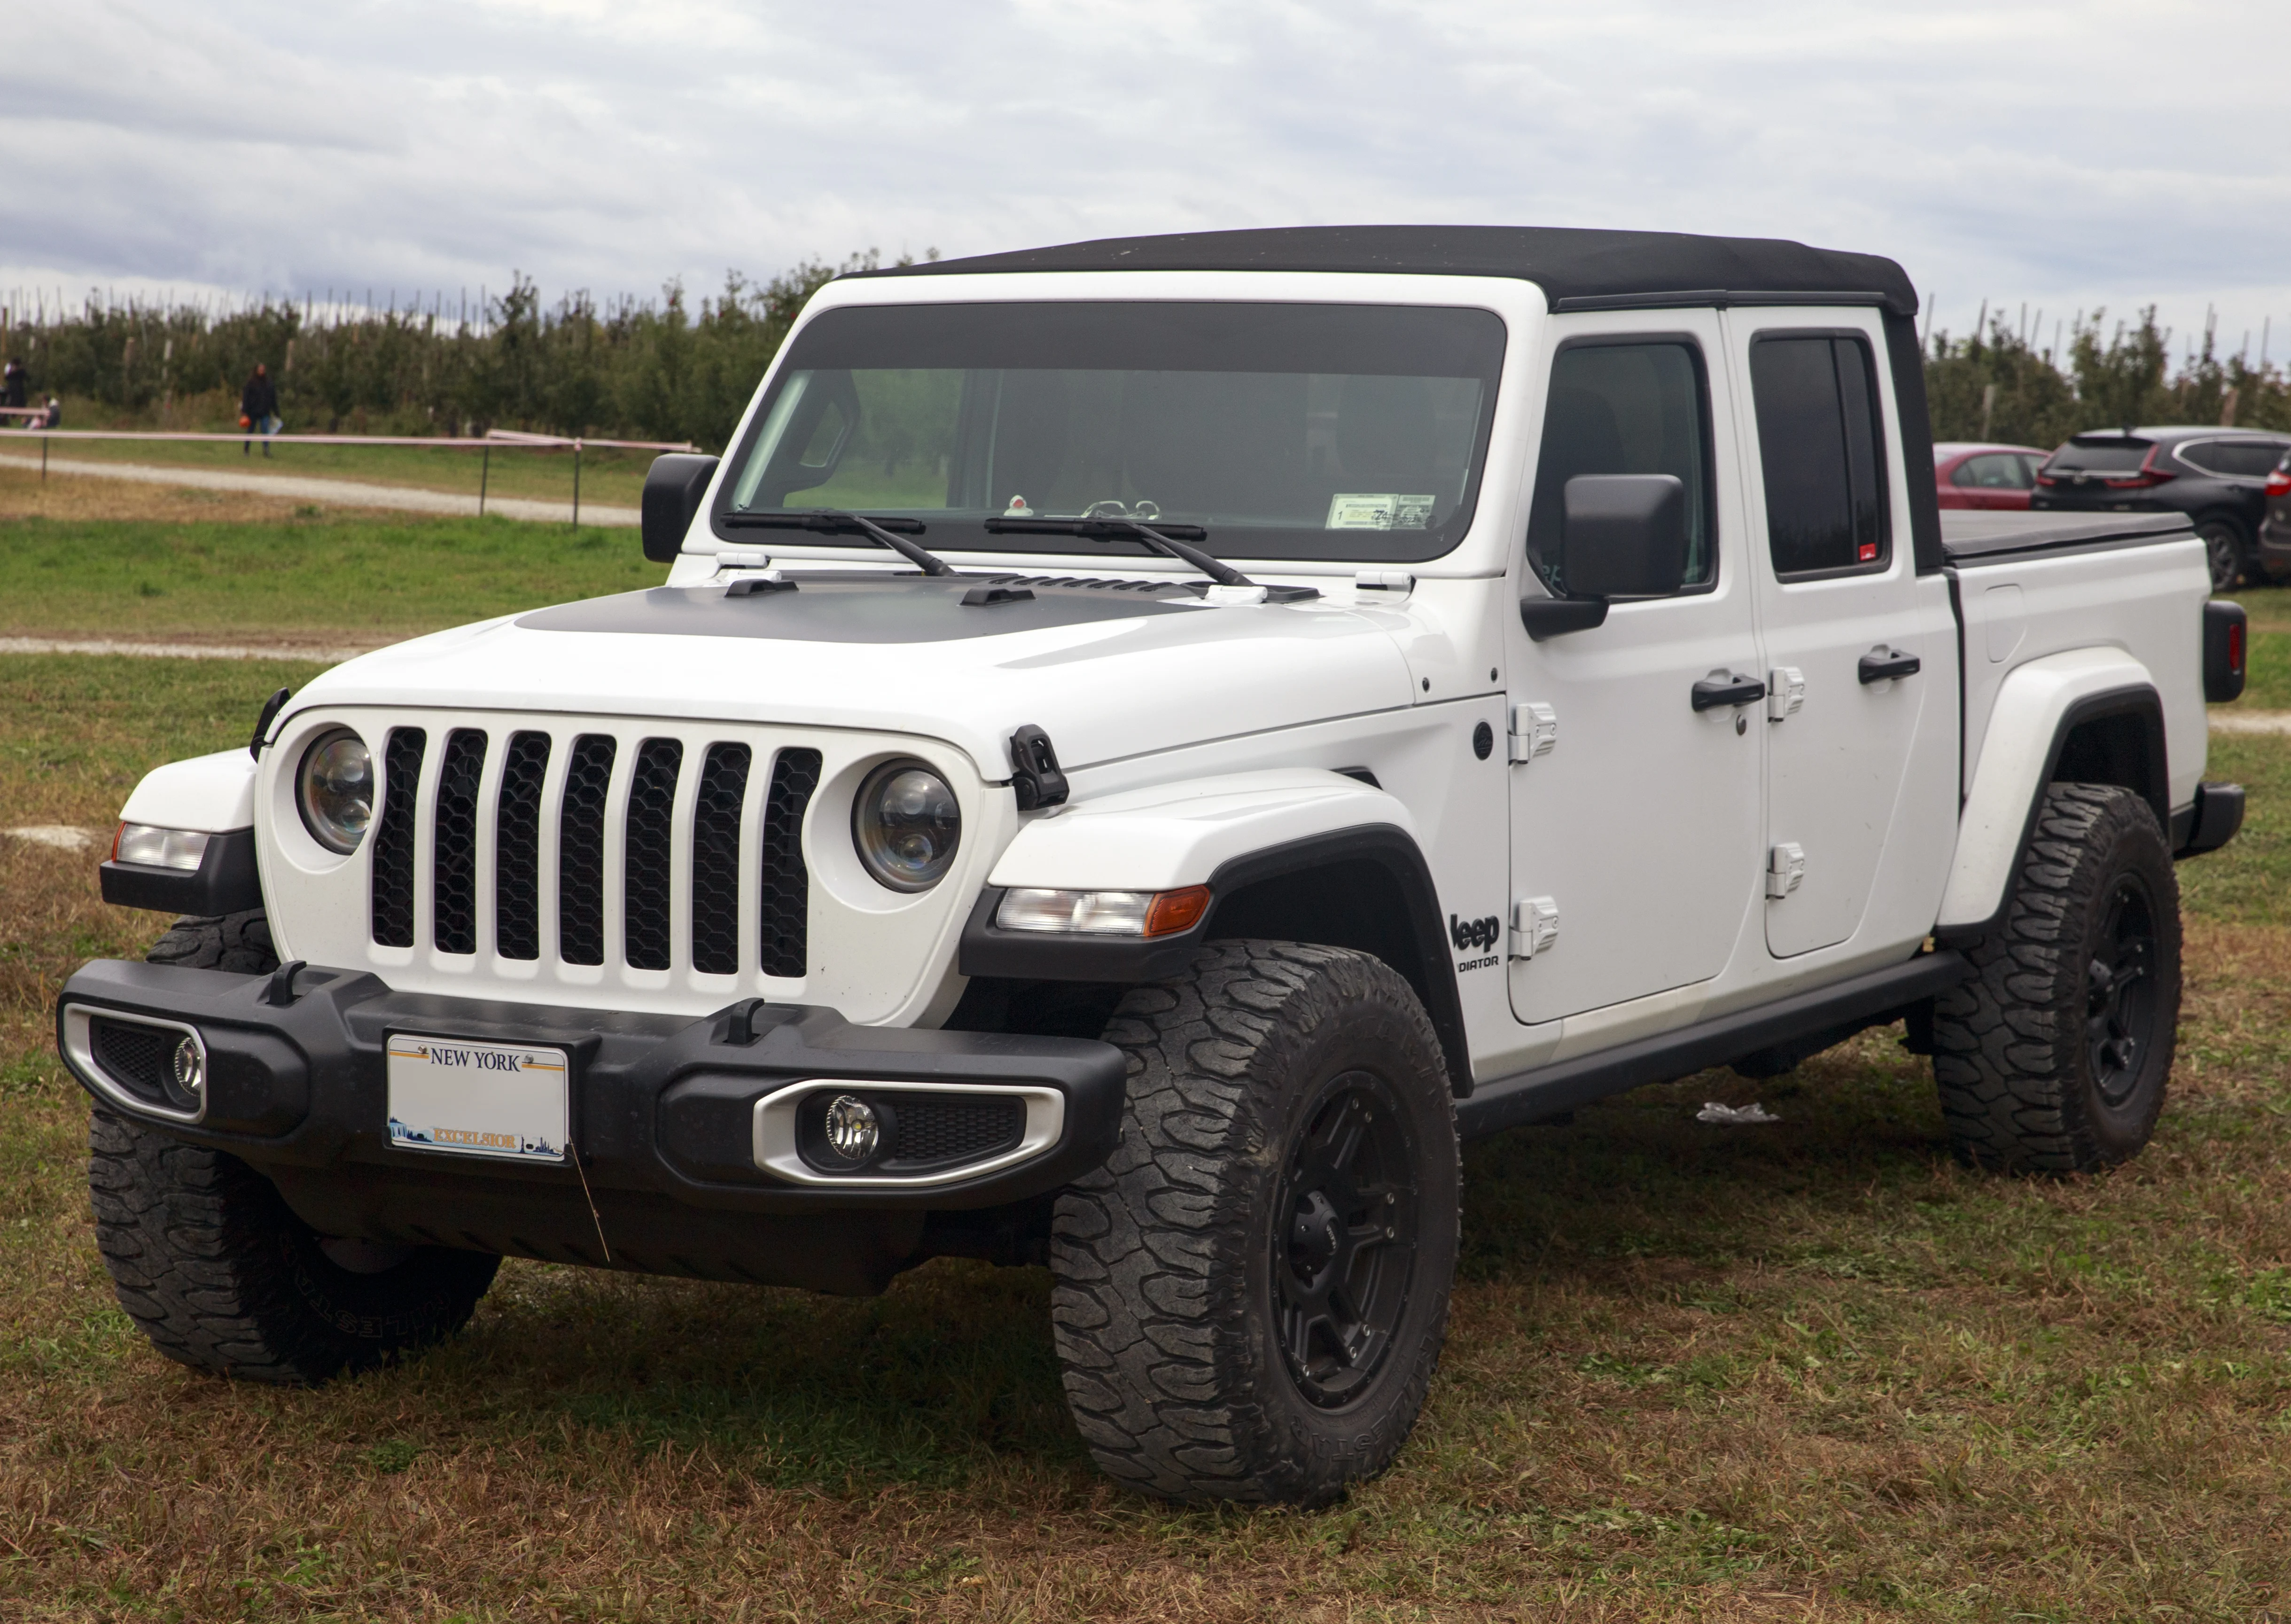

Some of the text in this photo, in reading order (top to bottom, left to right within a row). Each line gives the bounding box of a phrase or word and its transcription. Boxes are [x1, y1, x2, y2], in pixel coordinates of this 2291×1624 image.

[1458, 955, 1499, 973] DIATOR
[430, 1047, 521, 1072] NEW YORK
[433, 1128, 516, 1149] EXCELSIOR
